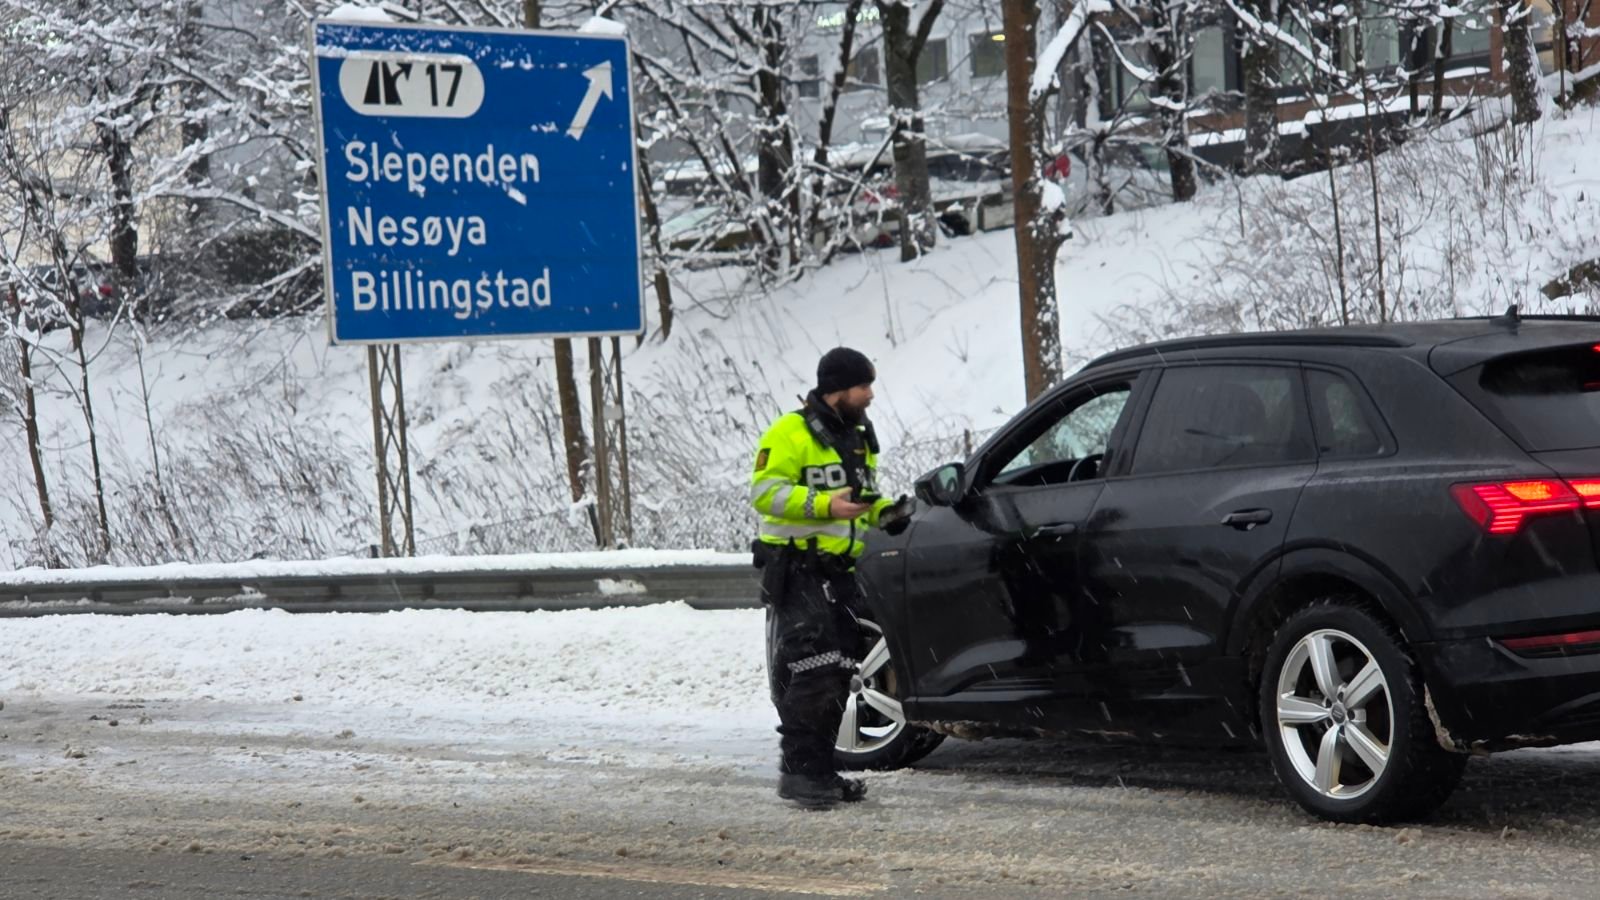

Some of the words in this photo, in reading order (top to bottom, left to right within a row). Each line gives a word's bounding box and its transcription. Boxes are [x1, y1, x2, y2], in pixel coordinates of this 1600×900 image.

[425, 63, 463, 107] 17
[345, 141, 540, 192] Slependen
[347, 206, 487, 256] Nesøya
[351, 266, 551, 319] Billingstad
